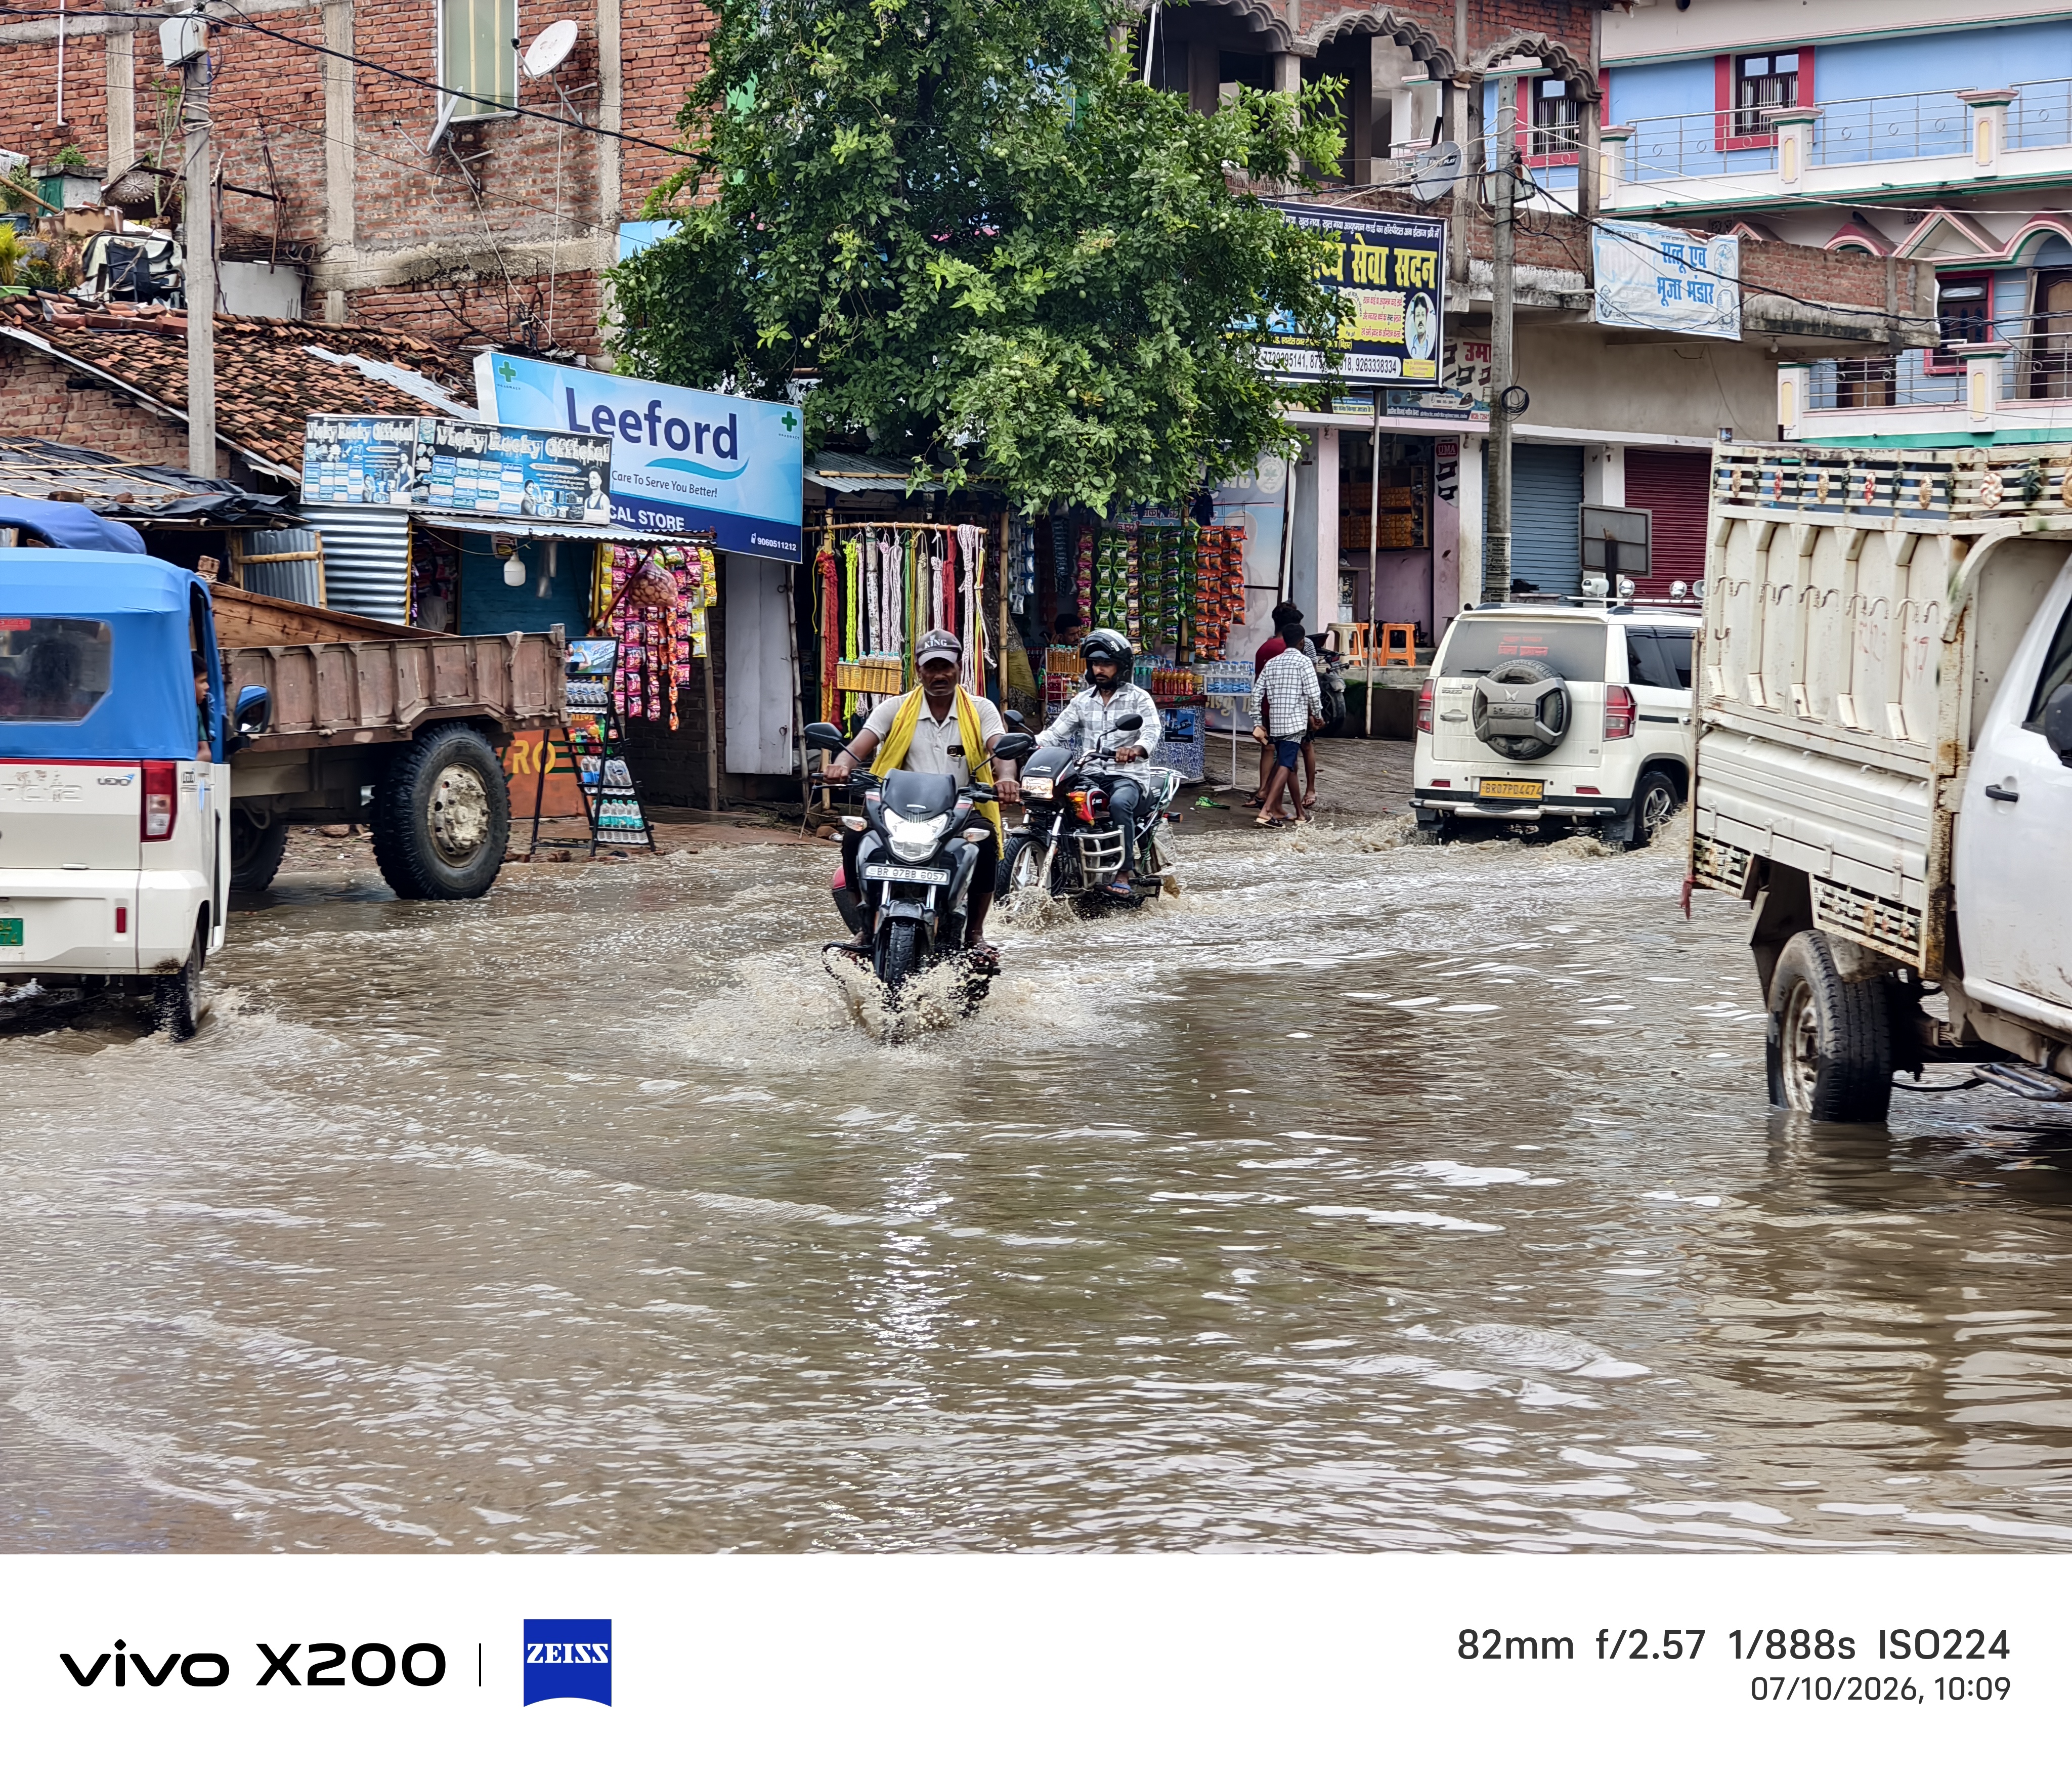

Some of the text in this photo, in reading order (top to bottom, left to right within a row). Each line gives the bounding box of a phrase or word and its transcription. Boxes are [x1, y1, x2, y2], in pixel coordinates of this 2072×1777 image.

[1351, 233, 1389, 285] सेवा
[1394, 248, 1437, 289] सदन
[1356, 358, 1397, 374] 9263338334
[566, 387, 738, 460] Leeford
[545, 437, 610, 466] Official
[1438, 445, 1455, 455] UMA
[612, 471, 718, 498] Care To Serve You Better!
[638, 510, 684, 530] STORE
[758, 537, 797, 552] 9060511212
[924, 639, 947, 649] KING
[877, 867, 889, 876] BR
